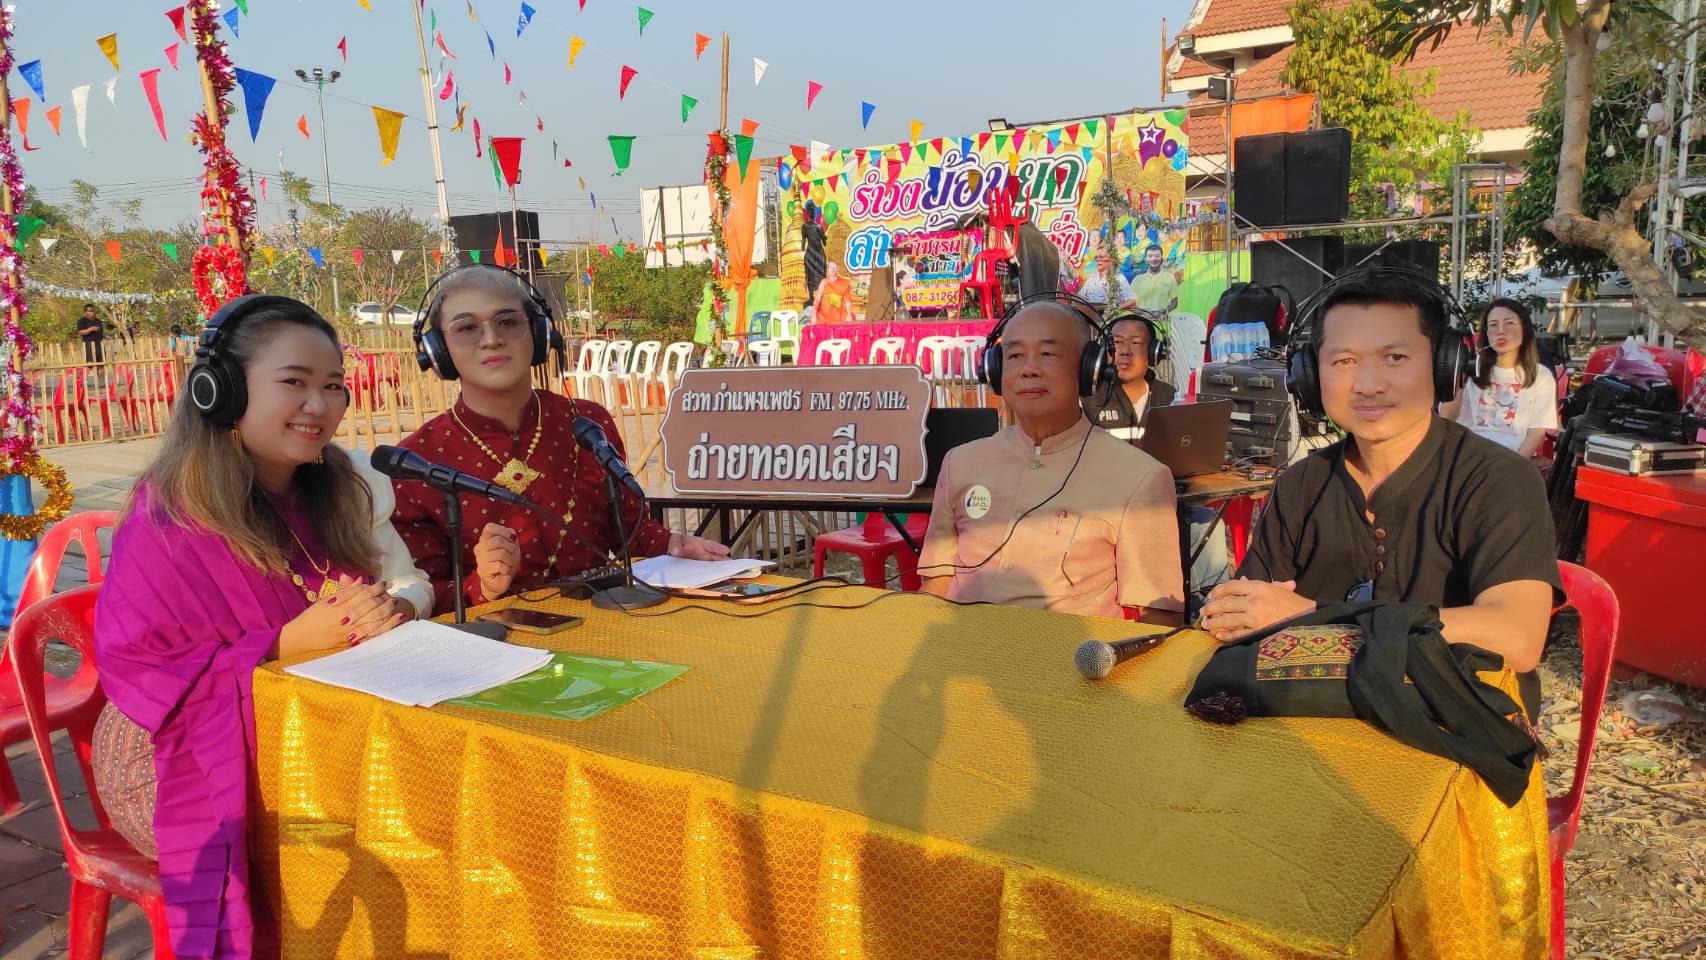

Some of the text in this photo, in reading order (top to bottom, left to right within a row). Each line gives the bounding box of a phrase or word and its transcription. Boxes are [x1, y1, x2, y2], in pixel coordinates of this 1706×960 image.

[810, 392, 835, 411] FM.
[839, 391, 871, 411] 97.75
[875, 391, 910, 410] MHz.
[688, 423, 899, 481] ถ่ายทอดเสียง
